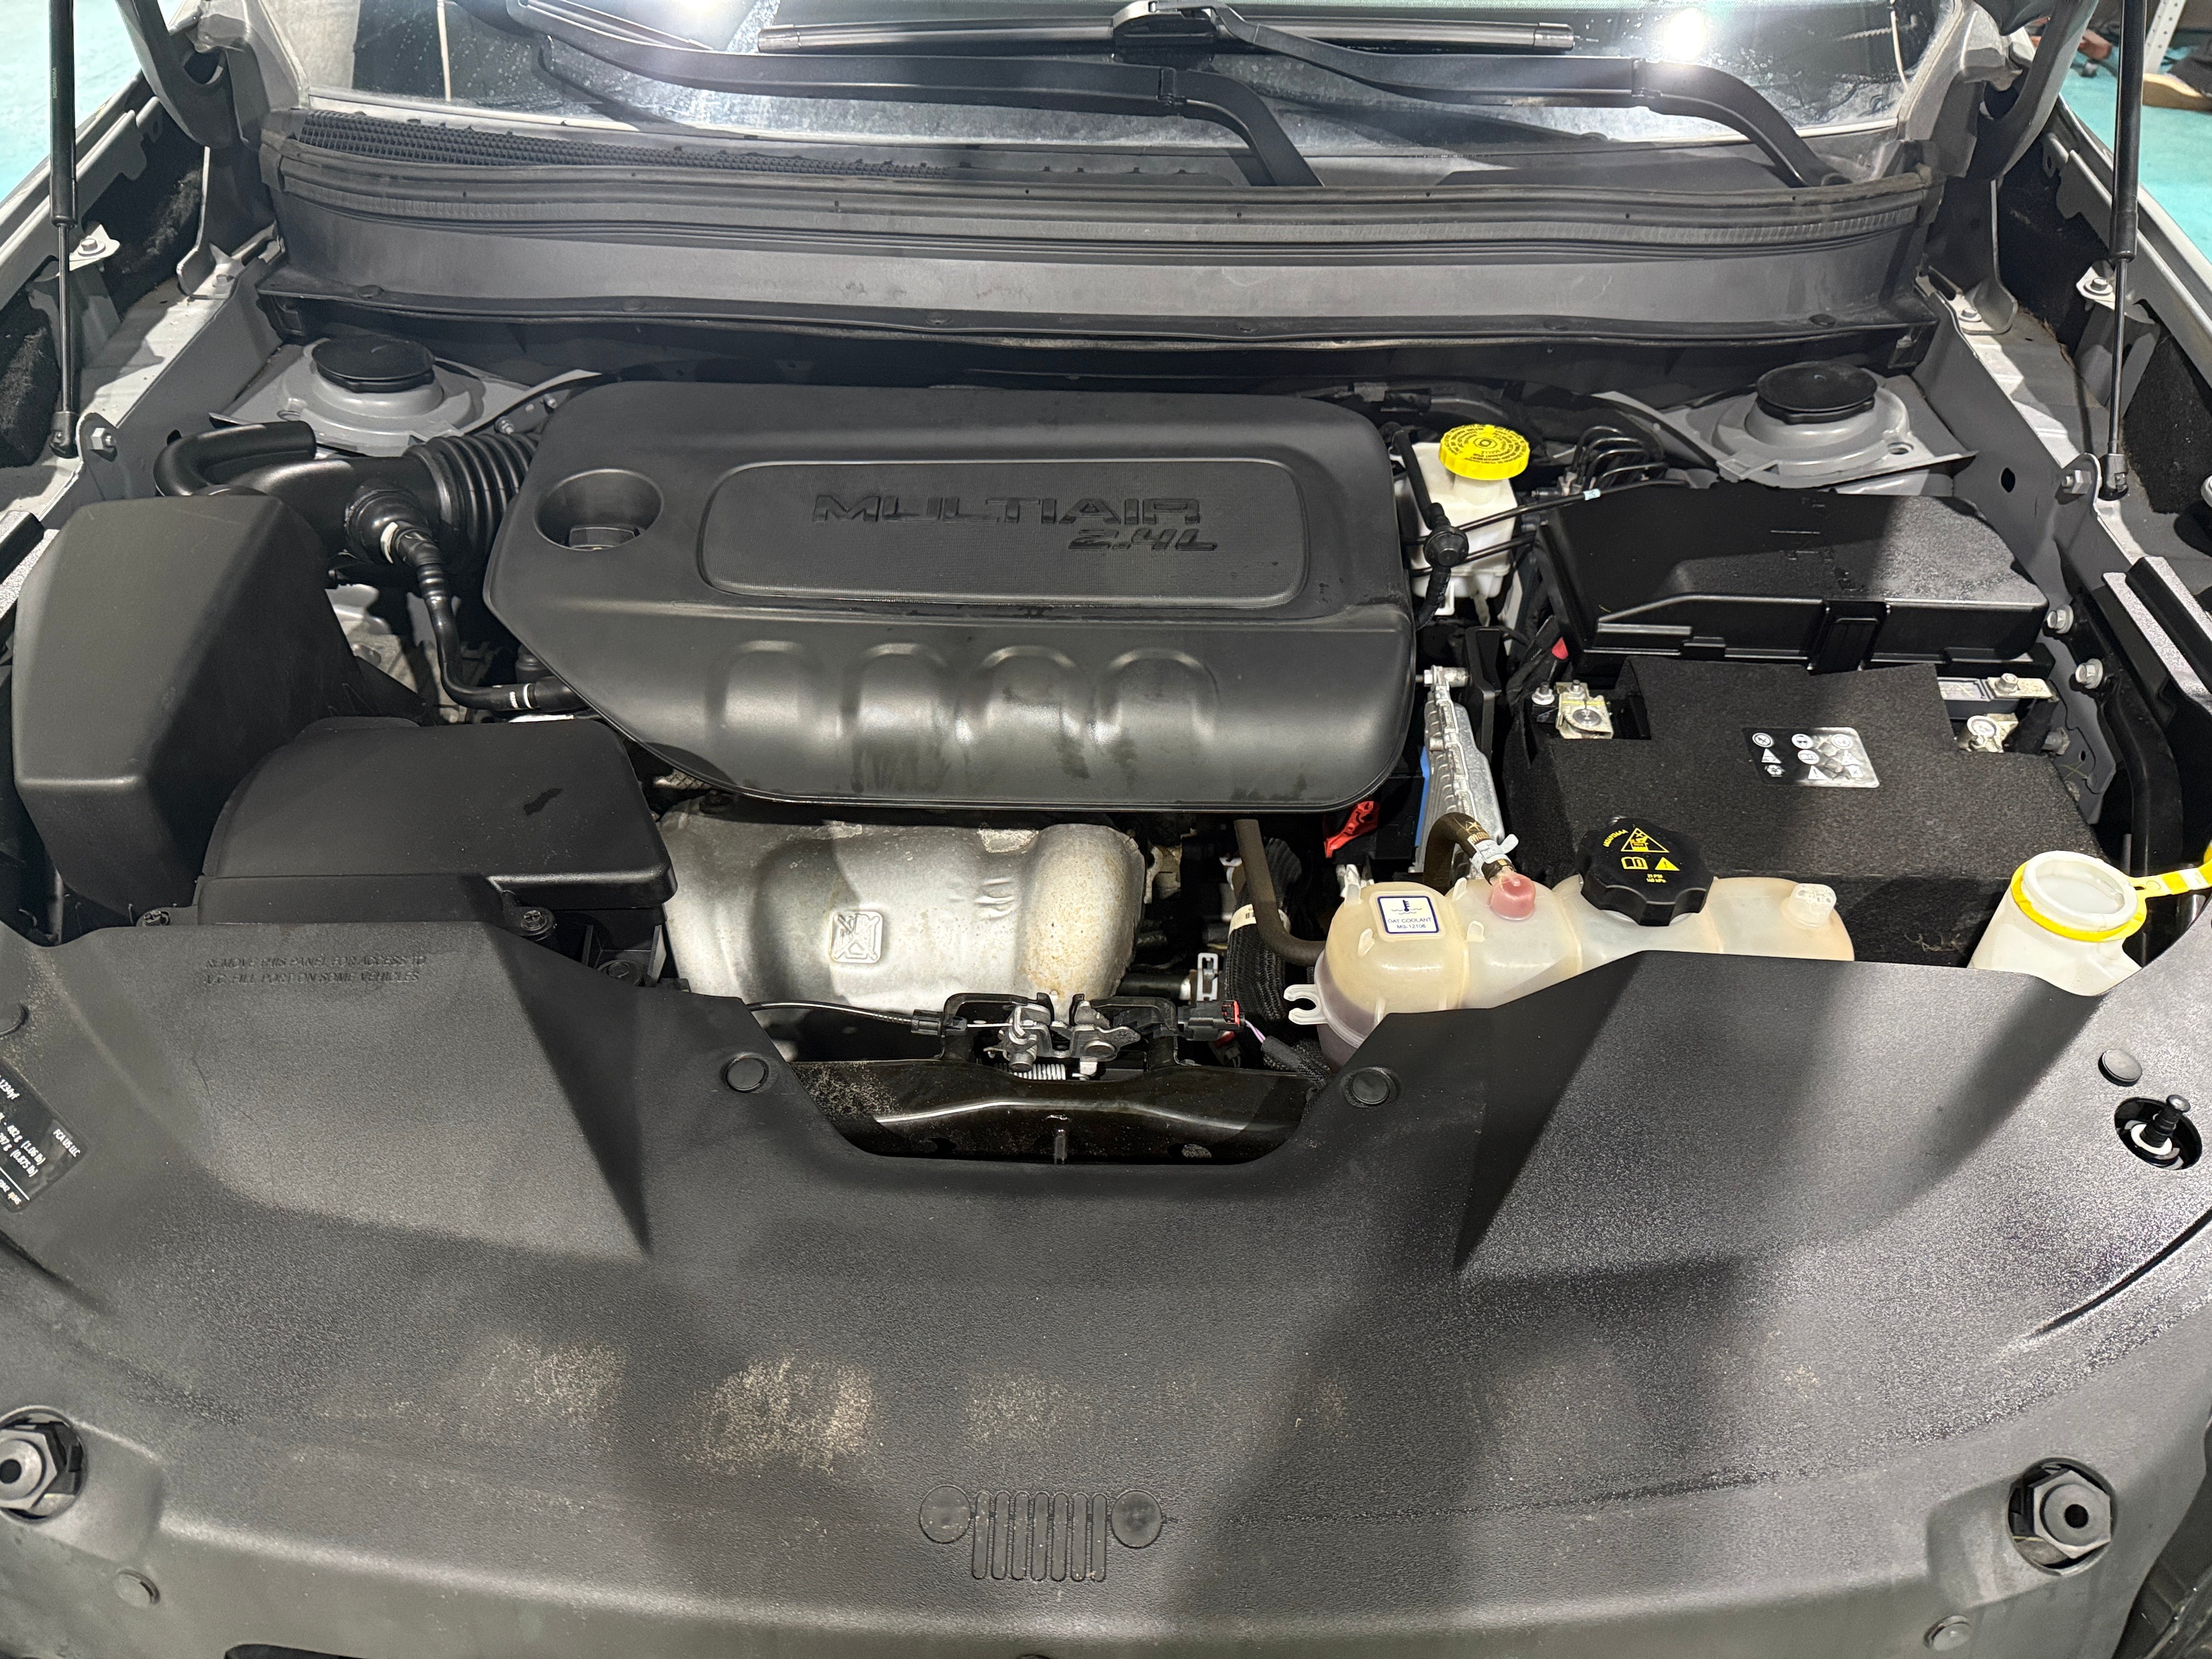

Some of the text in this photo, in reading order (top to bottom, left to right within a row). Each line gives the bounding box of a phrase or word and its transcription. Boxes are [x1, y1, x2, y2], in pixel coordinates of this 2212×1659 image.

[812, 494, 1203, 524] MULTIAIR
[1068, 528, 1217, 552] 2.4L
[332, 956, 357, 967] FOR
[359, 955, 407, 967] ACCESS
[411, 955, 426, 966] TO
[360, 970, 420, 983] VEHICLES
[7, 1125, 20, 1138] 482
[53, 1128, 81, 1158] FCA US LLC
